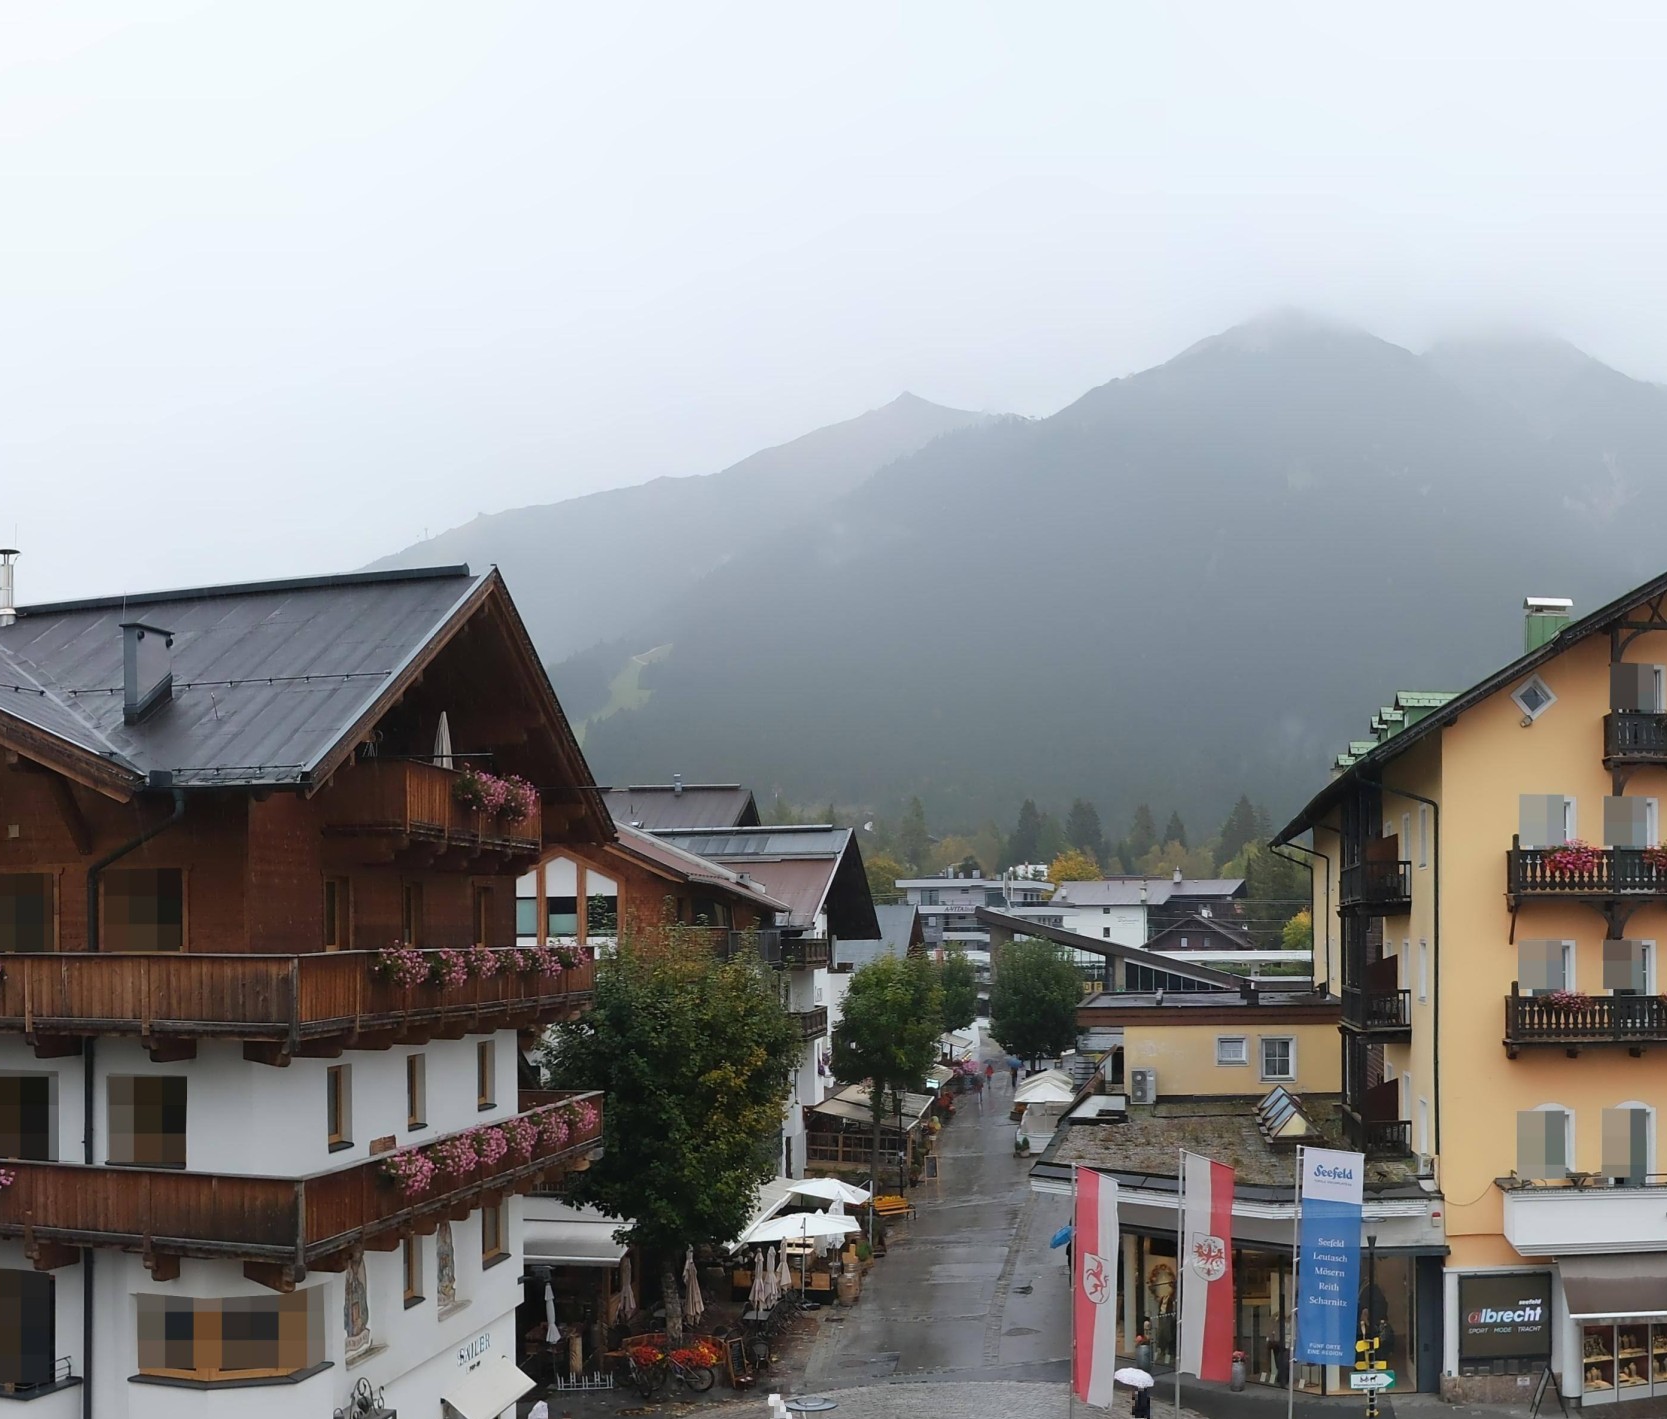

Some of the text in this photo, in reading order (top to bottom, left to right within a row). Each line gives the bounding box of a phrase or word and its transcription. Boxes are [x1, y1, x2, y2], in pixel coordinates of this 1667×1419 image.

[1314, 1164, 1353, 1180] Seefeld
[1318, 1237, 1345, 1248] Seefeld
[1313, 1252, 1348, 1263] Leutasch
[1314, 1267, 1345, 1277] Mösern
[1319, 1282, 1340, 1292] Reith
[1309, 1296, 1348, 1307] Scharnitz
[1468, 1307, 1542, 1324] albrecht
